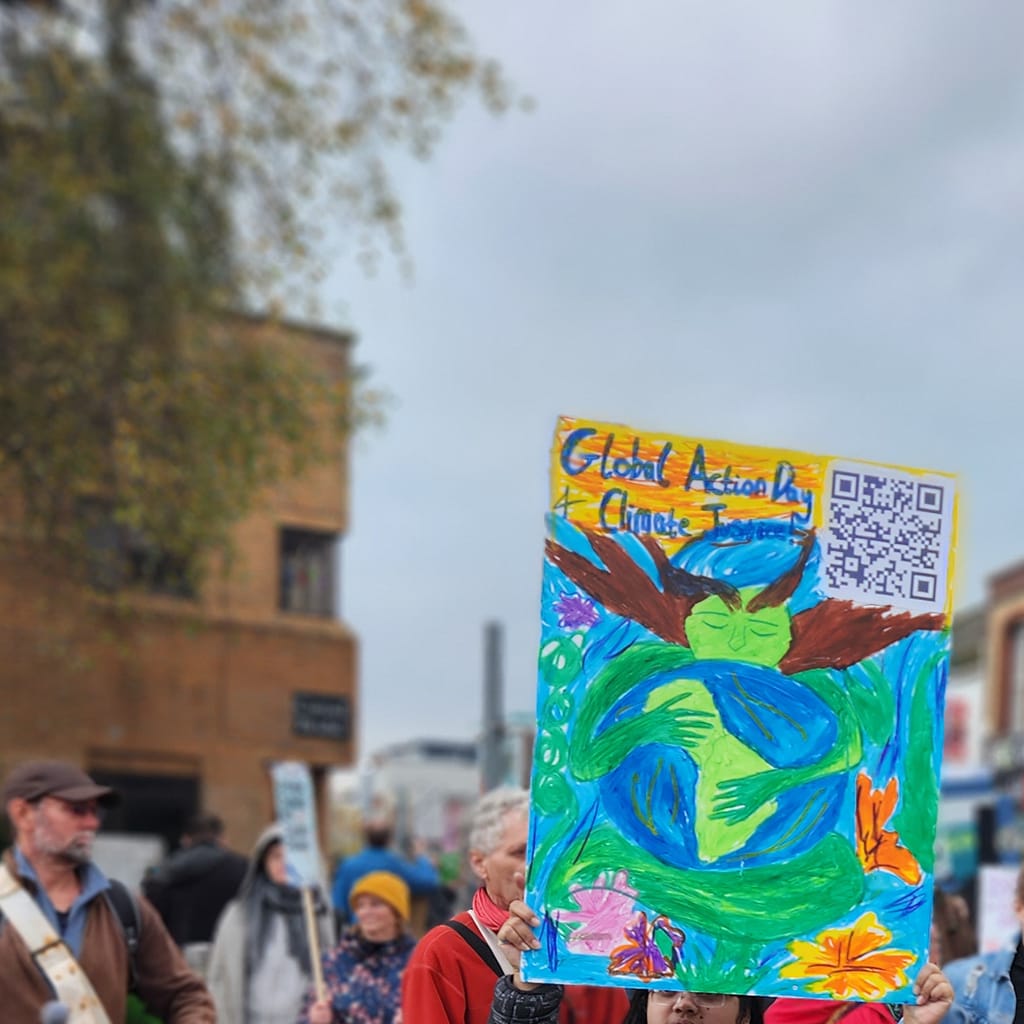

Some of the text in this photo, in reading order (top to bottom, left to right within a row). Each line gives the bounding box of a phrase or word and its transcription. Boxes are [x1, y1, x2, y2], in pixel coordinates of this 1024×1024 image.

[561, 428, 814, 524] Global Action Day
[599, 488, 690, 538] Climate
